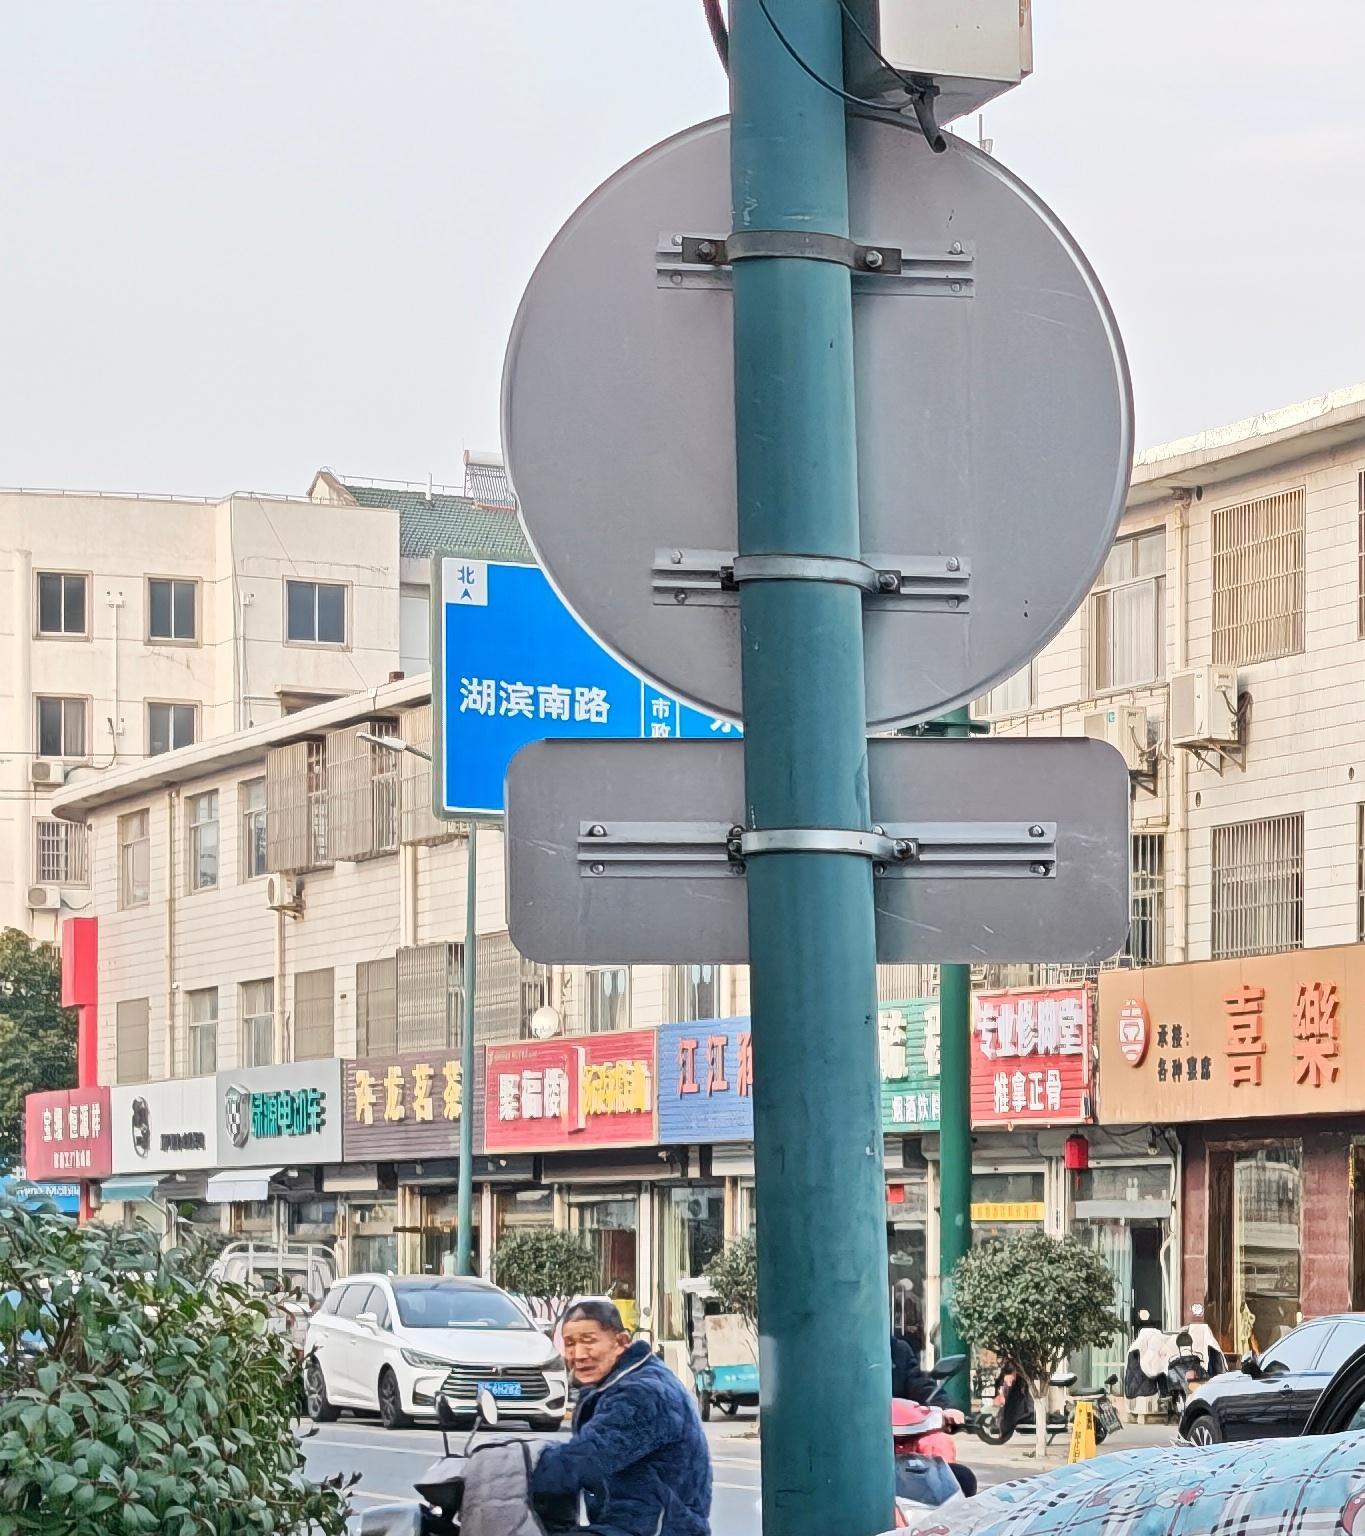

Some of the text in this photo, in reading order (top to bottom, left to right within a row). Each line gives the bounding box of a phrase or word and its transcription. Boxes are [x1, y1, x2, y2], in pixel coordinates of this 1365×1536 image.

[457, 566, 475, 585] 北
[459, 677, 610, 724] 湖滨南路
[994, 1068, 1062, 1113] 推拿正骨
